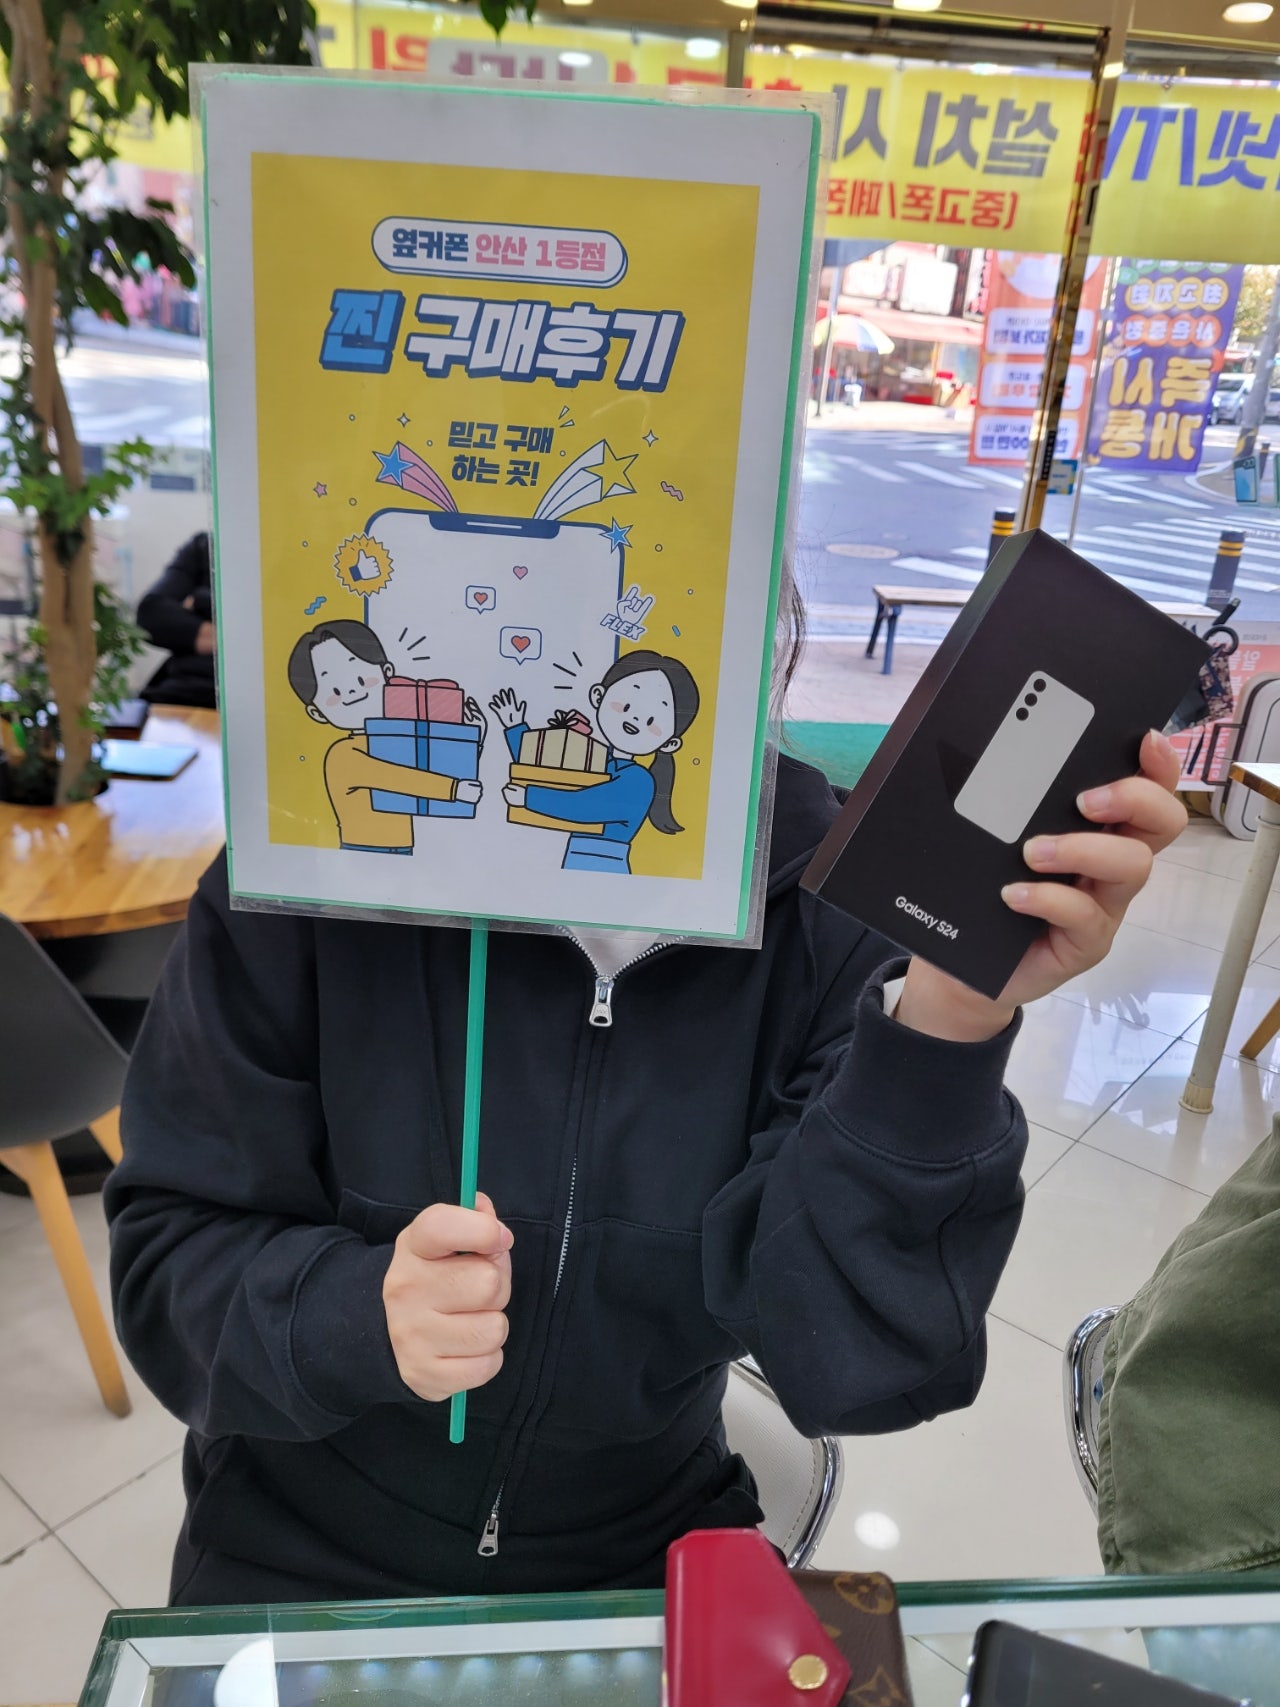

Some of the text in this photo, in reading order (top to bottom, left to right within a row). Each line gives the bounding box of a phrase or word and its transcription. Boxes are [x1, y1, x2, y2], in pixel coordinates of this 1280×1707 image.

[392, 228, 607, 273] 옆커폰 안산 1등점
[319, 289, 686, 393] 찐 구매후기
[448, 421, 554, 454] 믿고 구매
[451, 455, 540, 487] 하는 곳!
[600, 613, 646, 640] FLEX
[895, 896, 959, 940] Galaxy S24
